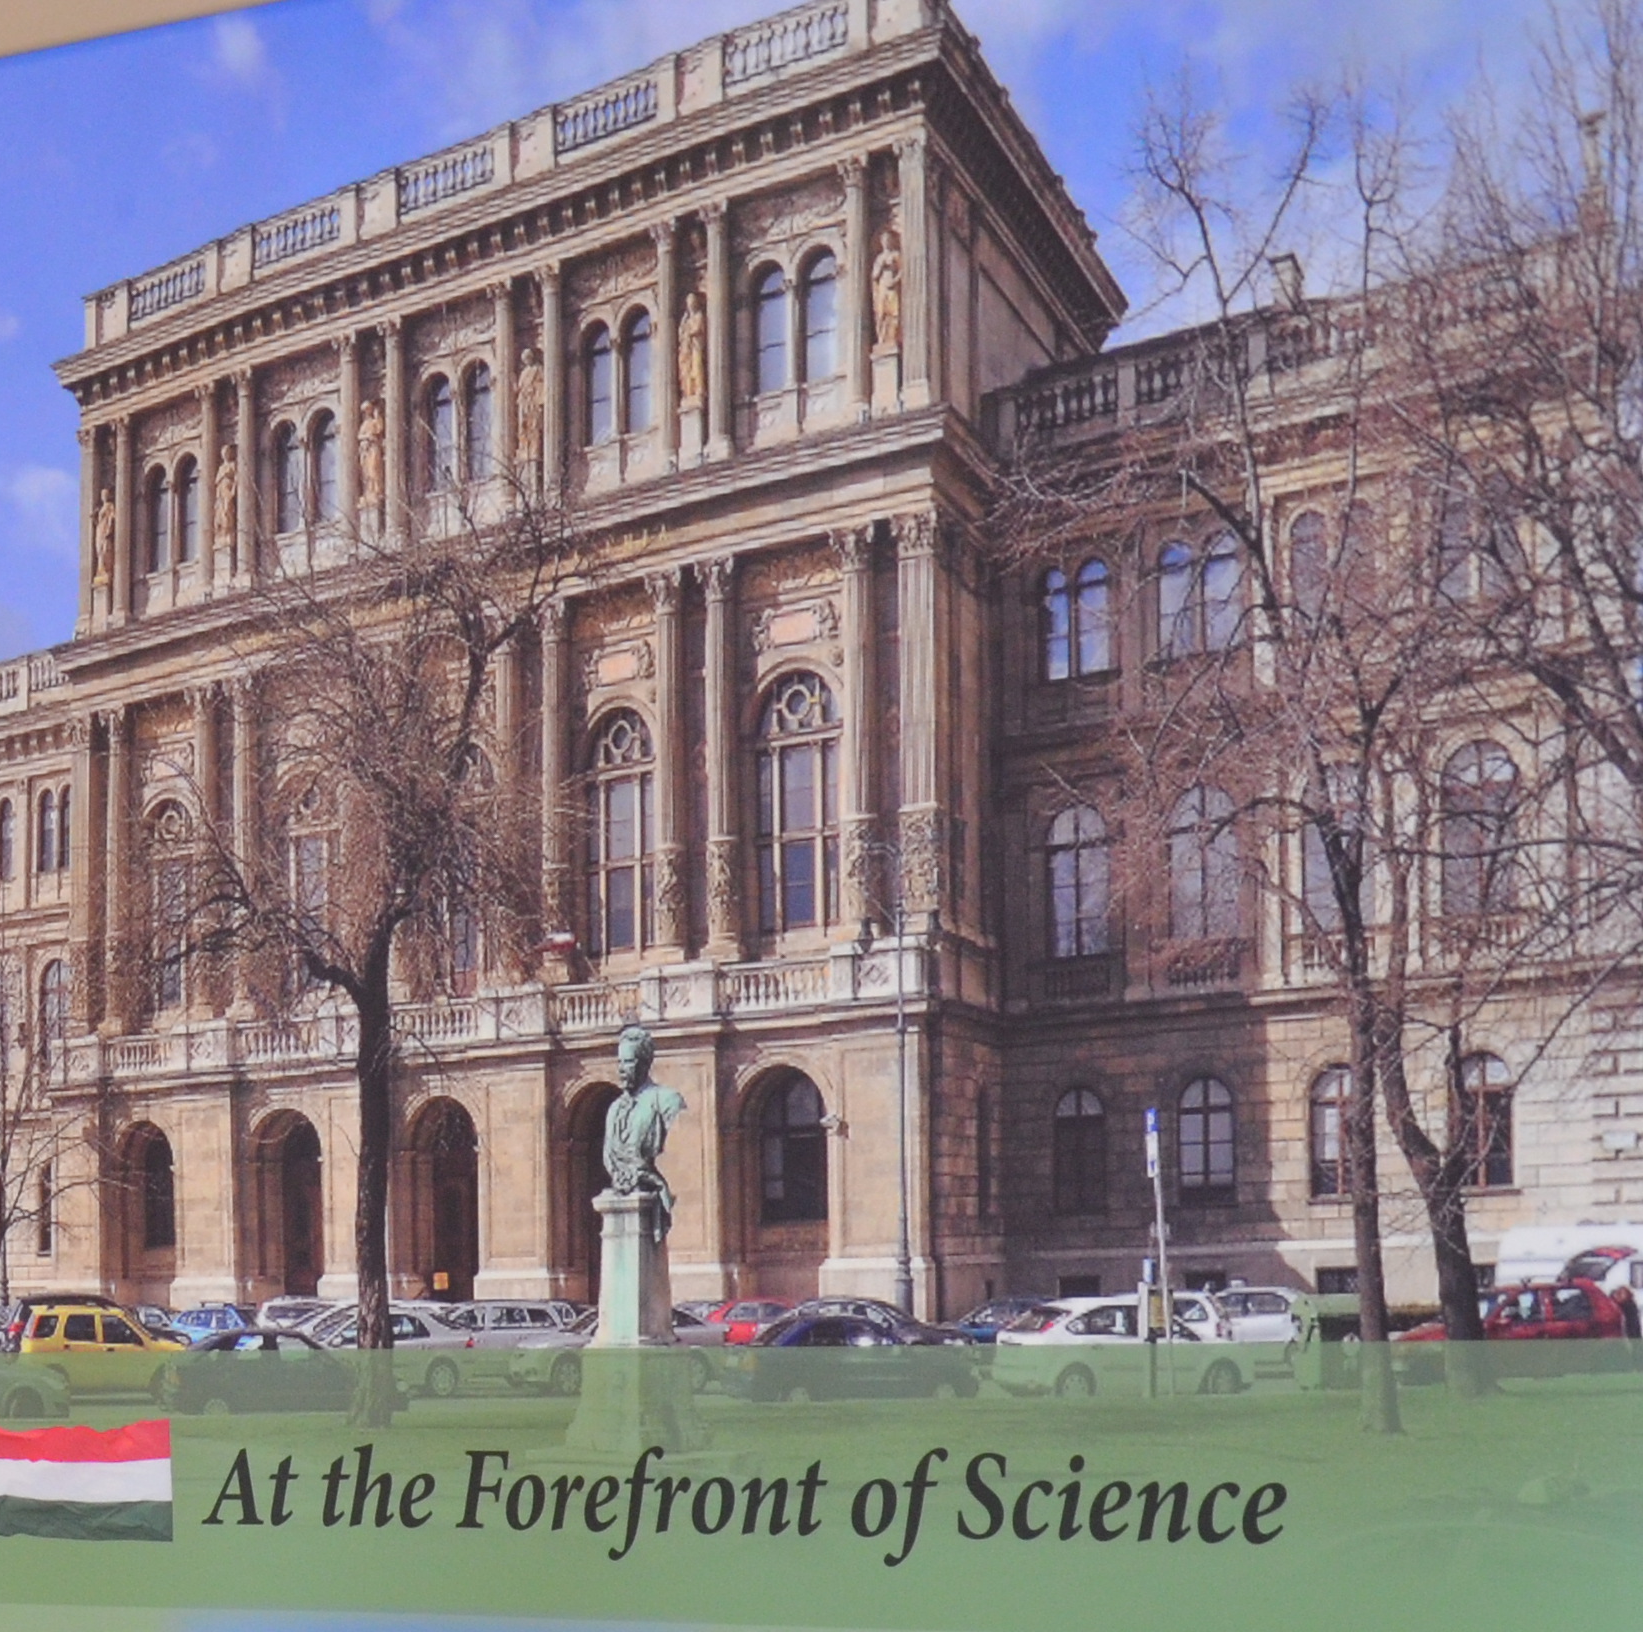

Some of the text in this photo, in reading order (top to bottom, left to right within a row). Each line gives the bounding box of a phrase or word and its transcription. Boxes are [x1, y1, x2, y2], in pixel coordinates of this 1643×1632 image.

[201, 1442, 1288, 1568] At the Forefront of Science
